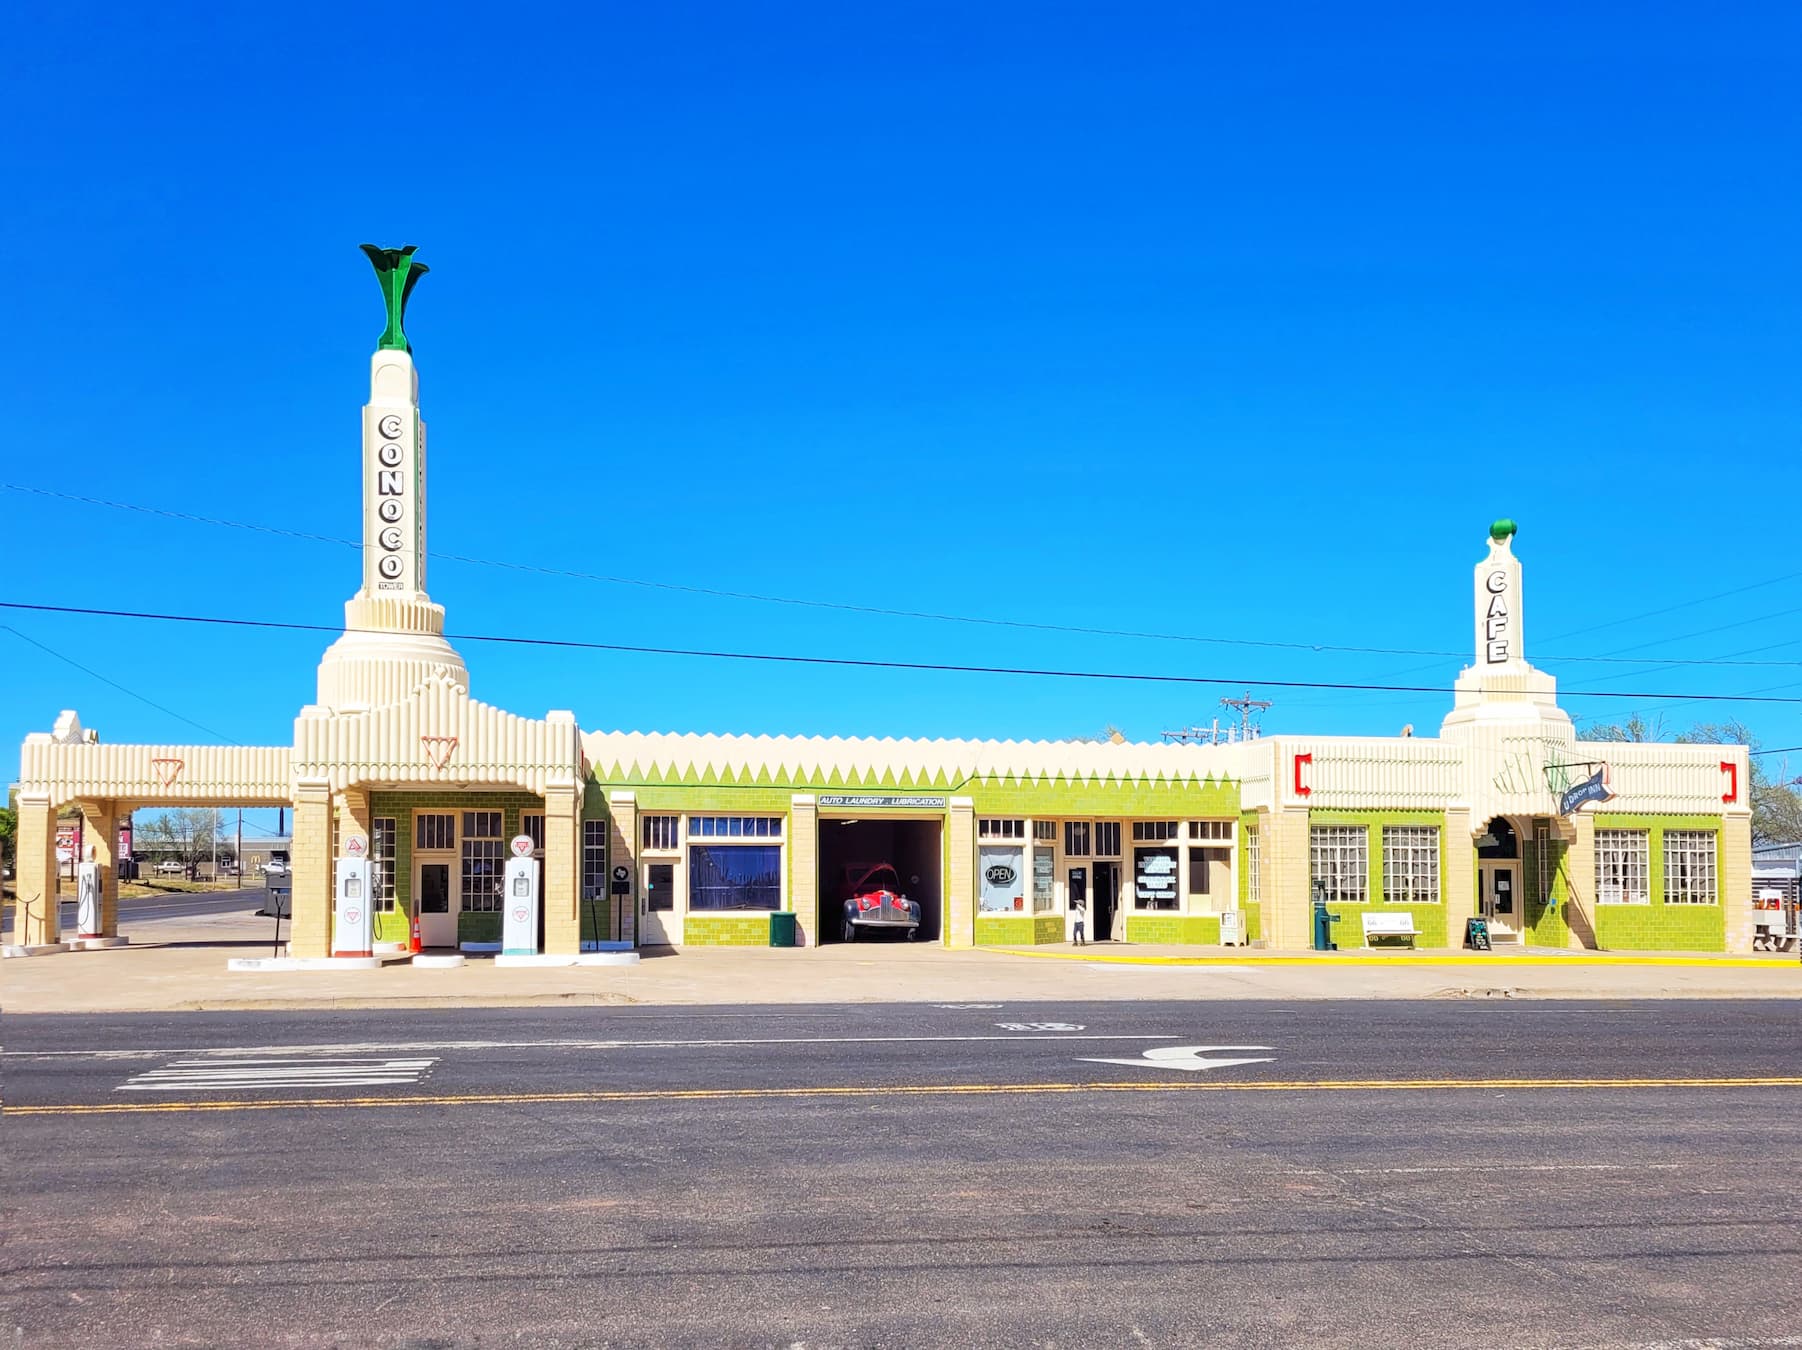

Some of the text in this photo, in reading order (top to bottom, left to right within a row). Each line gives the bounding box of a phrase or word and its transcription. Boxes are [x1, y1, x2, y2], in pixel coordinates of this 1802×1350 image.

[378, 414, 404, 580] CONOCO
[1486, 570, 1509, 664] CAFE
[821, 796, 944, 806] AUTO LAUNDRY LUBRICATION
[1563, 783, 1601, 810] U DROP INN
[986, 868, 1012, 880] OPEN
